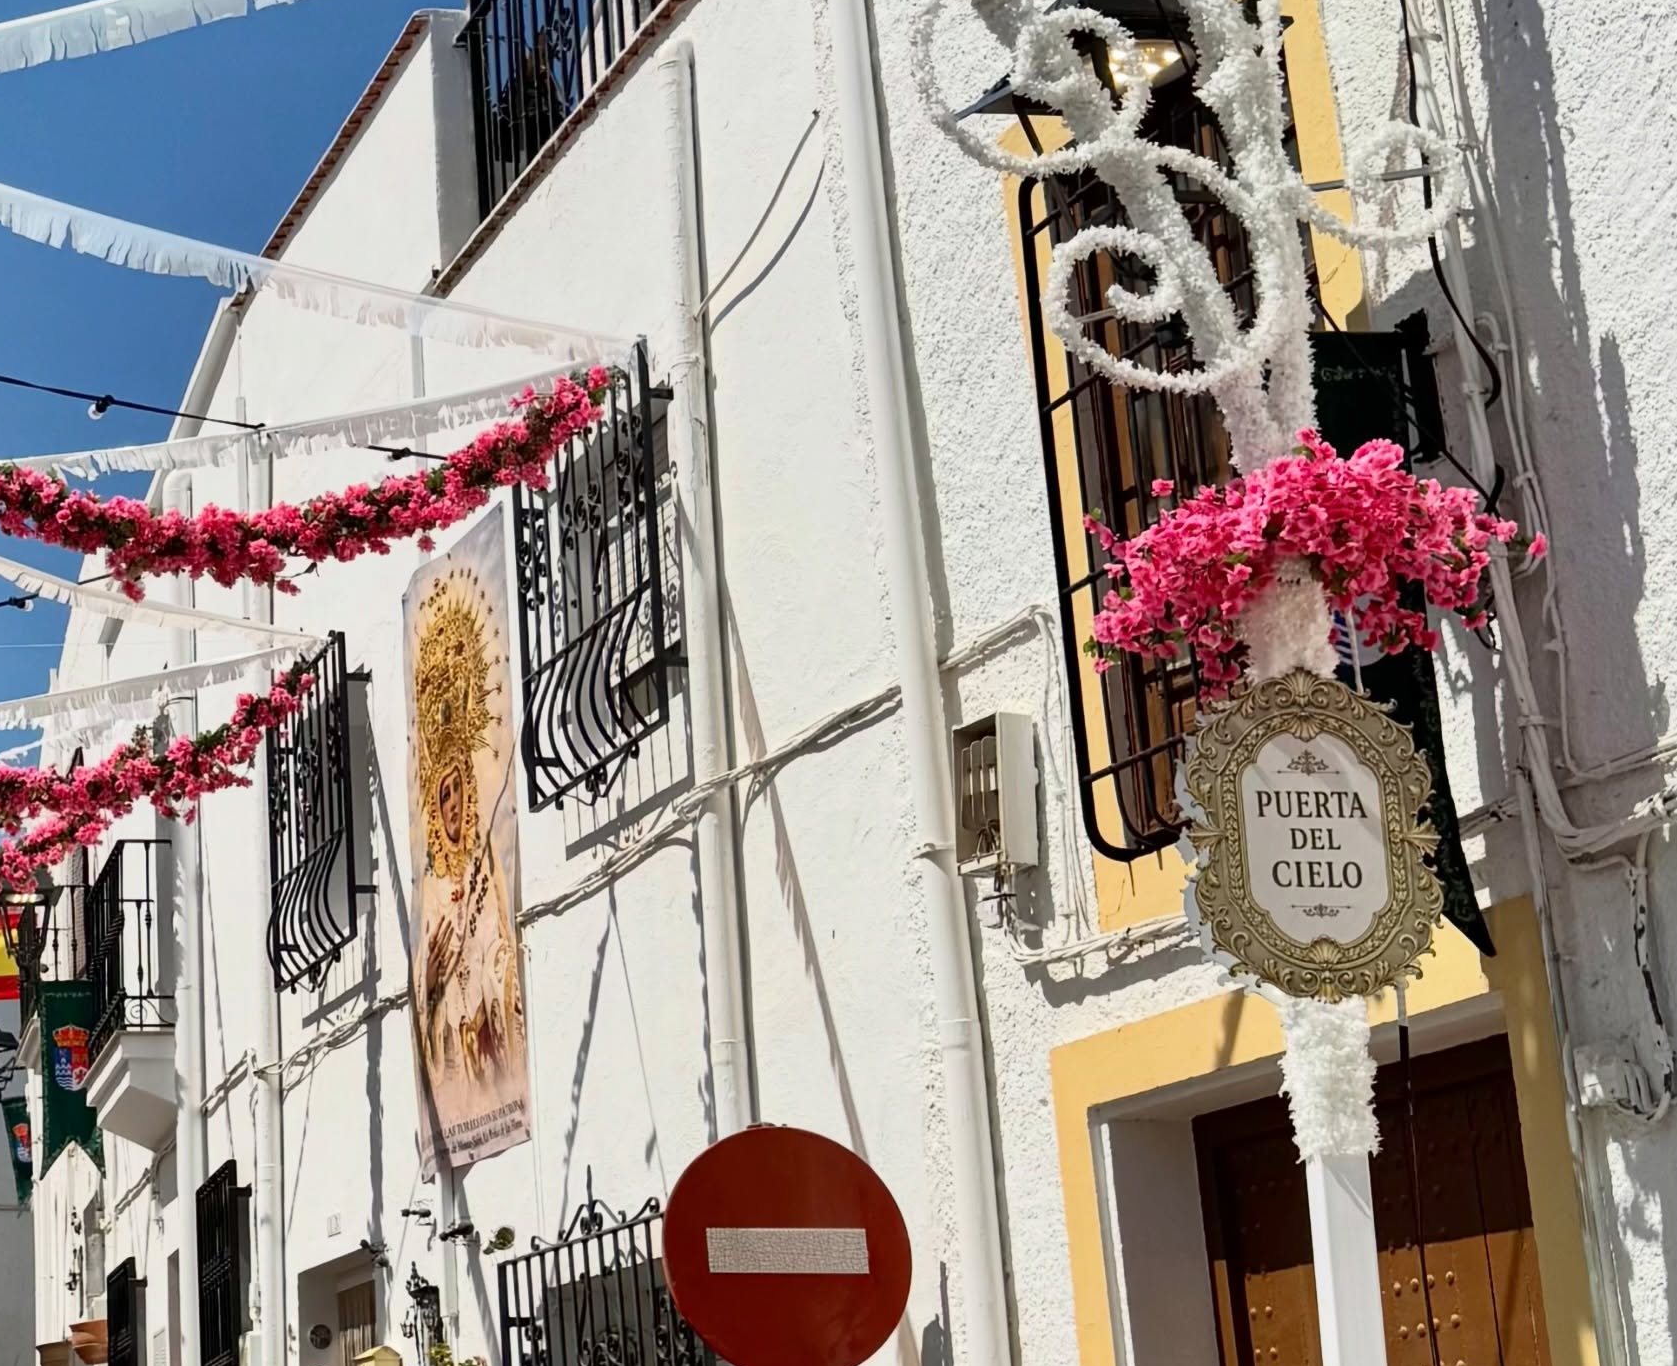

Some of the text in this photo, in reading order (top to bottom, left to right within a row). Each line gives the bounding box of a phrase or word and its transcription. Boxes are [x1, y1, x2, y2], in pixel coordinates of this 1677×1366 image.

[1255, 790, 1368, 819] PUERTA
[1290, 828, 1342, 851] DEL
[1271, 860, 1363, 889] CIELO
